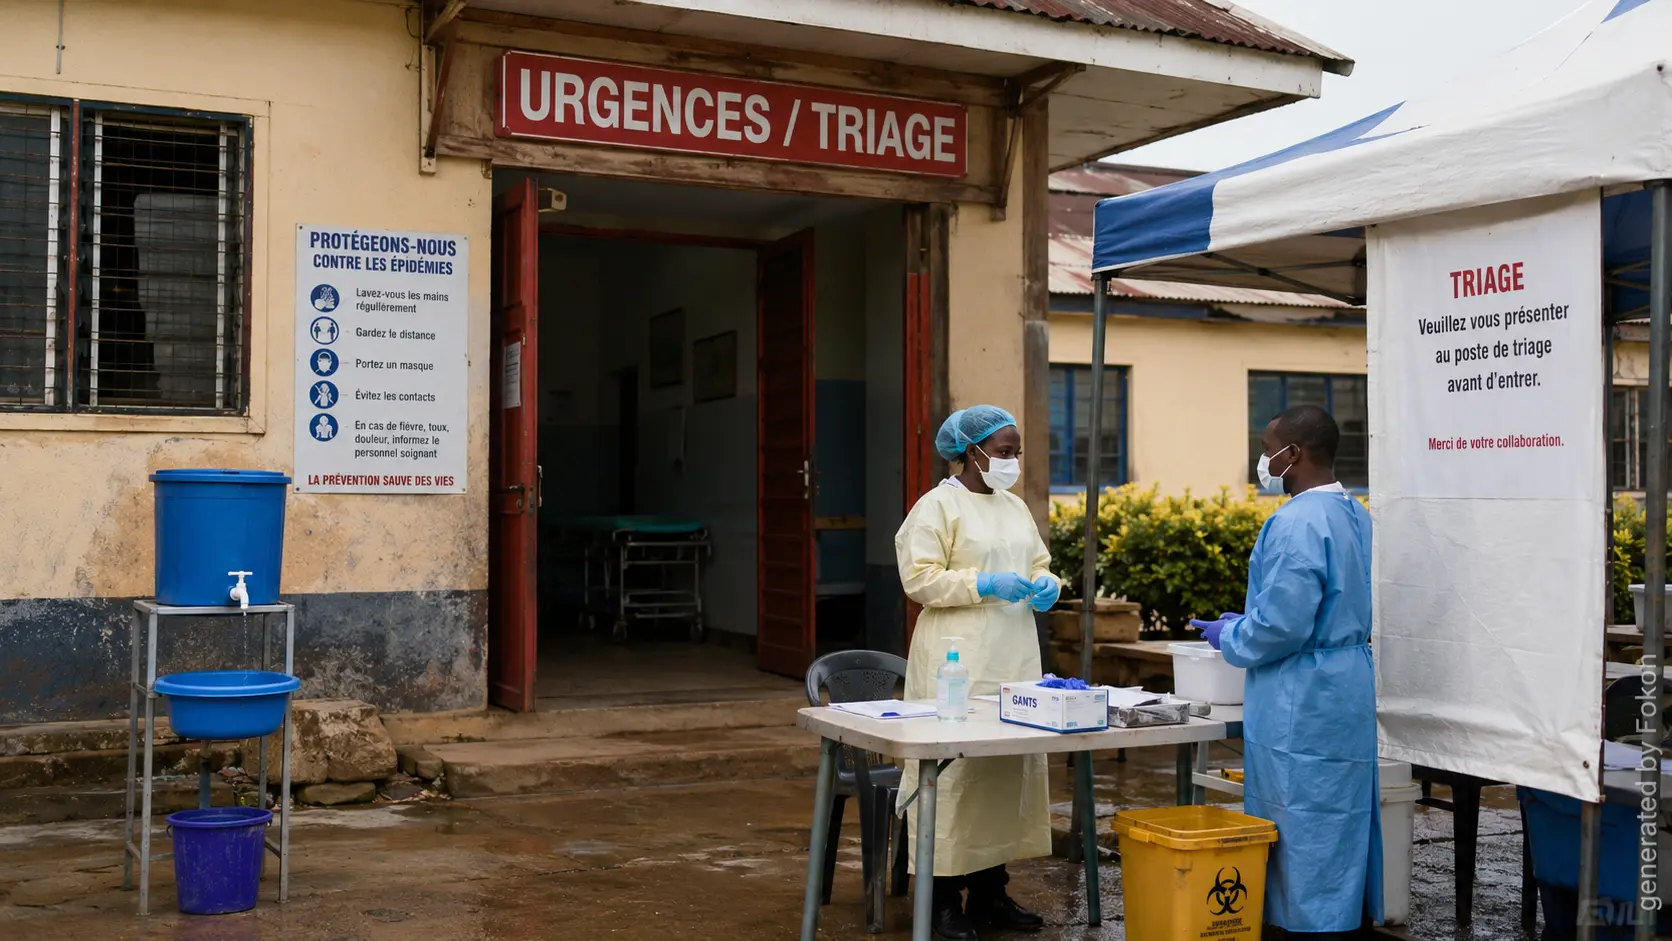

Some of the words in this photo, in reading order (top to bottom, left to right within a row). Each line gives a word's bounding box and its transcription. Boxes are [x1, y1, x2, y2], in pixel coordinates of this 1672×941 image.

[519, 68, 771, 144] URGENCES
[782, 98, 802, 148] /
[811, 102, 956, 163] TRIAGE
[310, 230, 457, 257] PROTÉGEONS-NOUS
[313, 254, 361, 270] CONTRE
[366, 256, 387, 271] LES
[390, 255, 453, 275] ÉPIDÉMIES
[1450, 261, 1525, 299] TRIAGE
[356, 287, 406, 300] Lavez-vous
[408, 290, 421, 300] les
[423, 291, 449, 302] mains
[1418, 315, 1467, 336] Veuillez
[1470, 313, 1500, 329] vous
[1504, 303, 1570, 330] présenter
[355, 327, 386, 338] Gardez
[399, 328, 436, 341] distance
[1435, 348, 1451, 364] au
[1454, 343, 1489, 366] poste
[1493, 340, 1509, 358] de
[1513, 339, 1552, 359] triage
[355, 358, 384, 370] Portez
[386, 361, 397, 370] un
[399, 362, 434, 372] masque
[1447, 373, 1482, 393] avant
[1486, 371, 1541, 390] d'entrer.
[355, 389, 381, 401] Évitez
[383, 390, 397, 401] les
[399, 392, 436, 402] contacts
[355, 420, 366, 430] En
[368, 423, 384, 431] cas
[386, 421, 397, 431] de
[428, 423, 450, 433] toux,
[355, 434, 390, 445] douleur,
[392, 434, 429, 445] informez
[431, 436, 440, 445] le
[1428, 436, 1454, 451] Merci
[1456, 437, 1467, 449] de
[1470, 436, 1494, 449] votre
[1496, 433, 1564, 449] collaboration.
[354, 448, 398, 459] personnel
[400, 449, 437, 460] soignant
[308, 475, 319, 486] LA
[322, 472, 380, 486] PRÉVENTION
[383, 475, 412, 486] SAUVE
[415, 475, 432, 486] DES
[434, 475, 454, 486] VIES
[1012, 694, 1038, 709] GANTS
